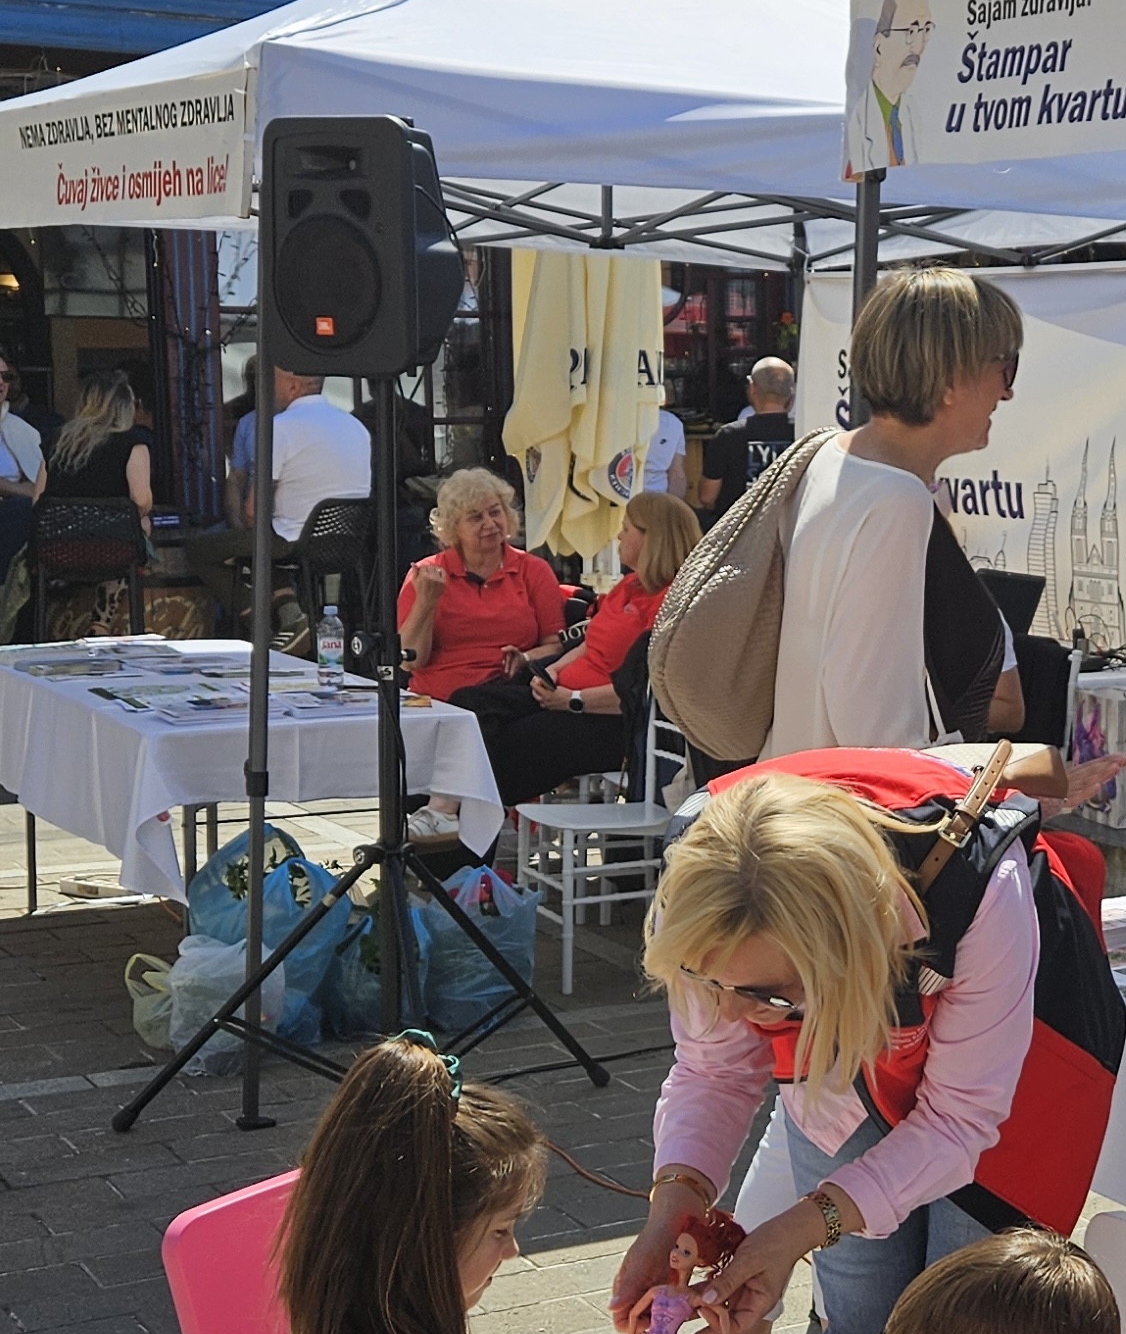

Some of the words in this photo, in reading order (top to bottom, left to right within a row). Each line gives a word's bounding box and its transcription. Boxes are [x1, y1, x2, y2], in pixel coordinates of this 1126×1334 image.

[957, 30, 1073, 85] Štampar
[19, 123, 46, 149] NEMA
[45, 115, 94, 145] ZDRAVLJA,
[94, 112, 115, 138] BEZ
[116, 102, 177, 135] MENTALNOG
[180, 94, 234, 127] ZDRAVLJA
[945, 103, 966, 133] u
[972, 92, 1032, 133] tvom
[57, 162, 88, 211] Čuvaj
[90, 166, 119, 202] živce
[121, 164, 126, 200] i
[128, 160, 182, 206] osmijeh
[186, 167, 204, 196] na
[207, 153, 229, 194] lice!
[939, 469, 1025, 519] vartu
